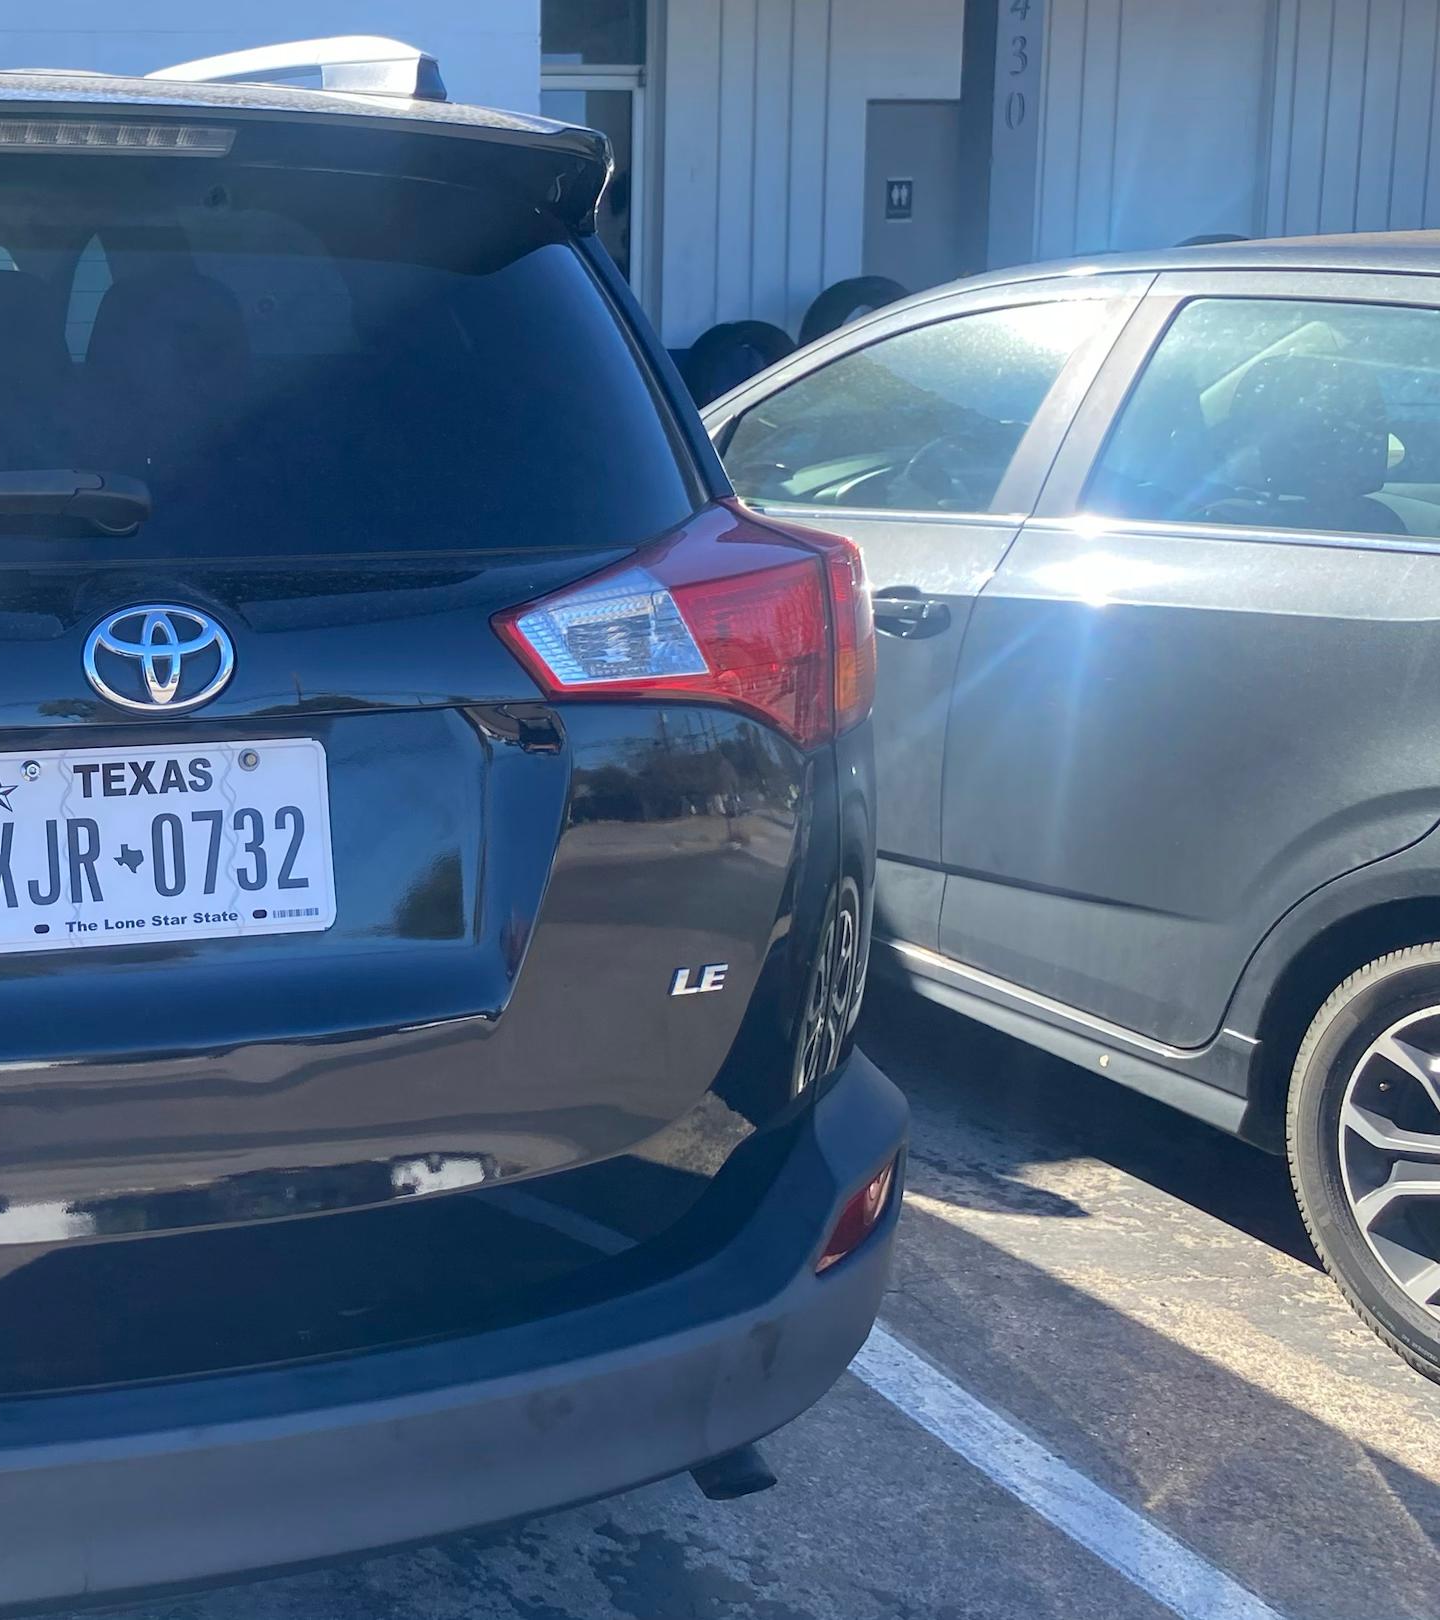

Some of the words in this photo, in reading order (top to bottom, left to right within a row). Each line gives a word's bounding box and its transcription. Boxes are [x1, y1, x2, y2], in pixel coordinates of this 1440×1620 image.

[72, 757, 214, 799] TEXAS
[150, 805, 310, 898] 0732
[65, 920, 98, 933] The
[104, 918, 146, 931] Lone
[151, 914, 188, 927] Star
[193, 911, 239, 924] State
[667, 962, 729, 996] LE
